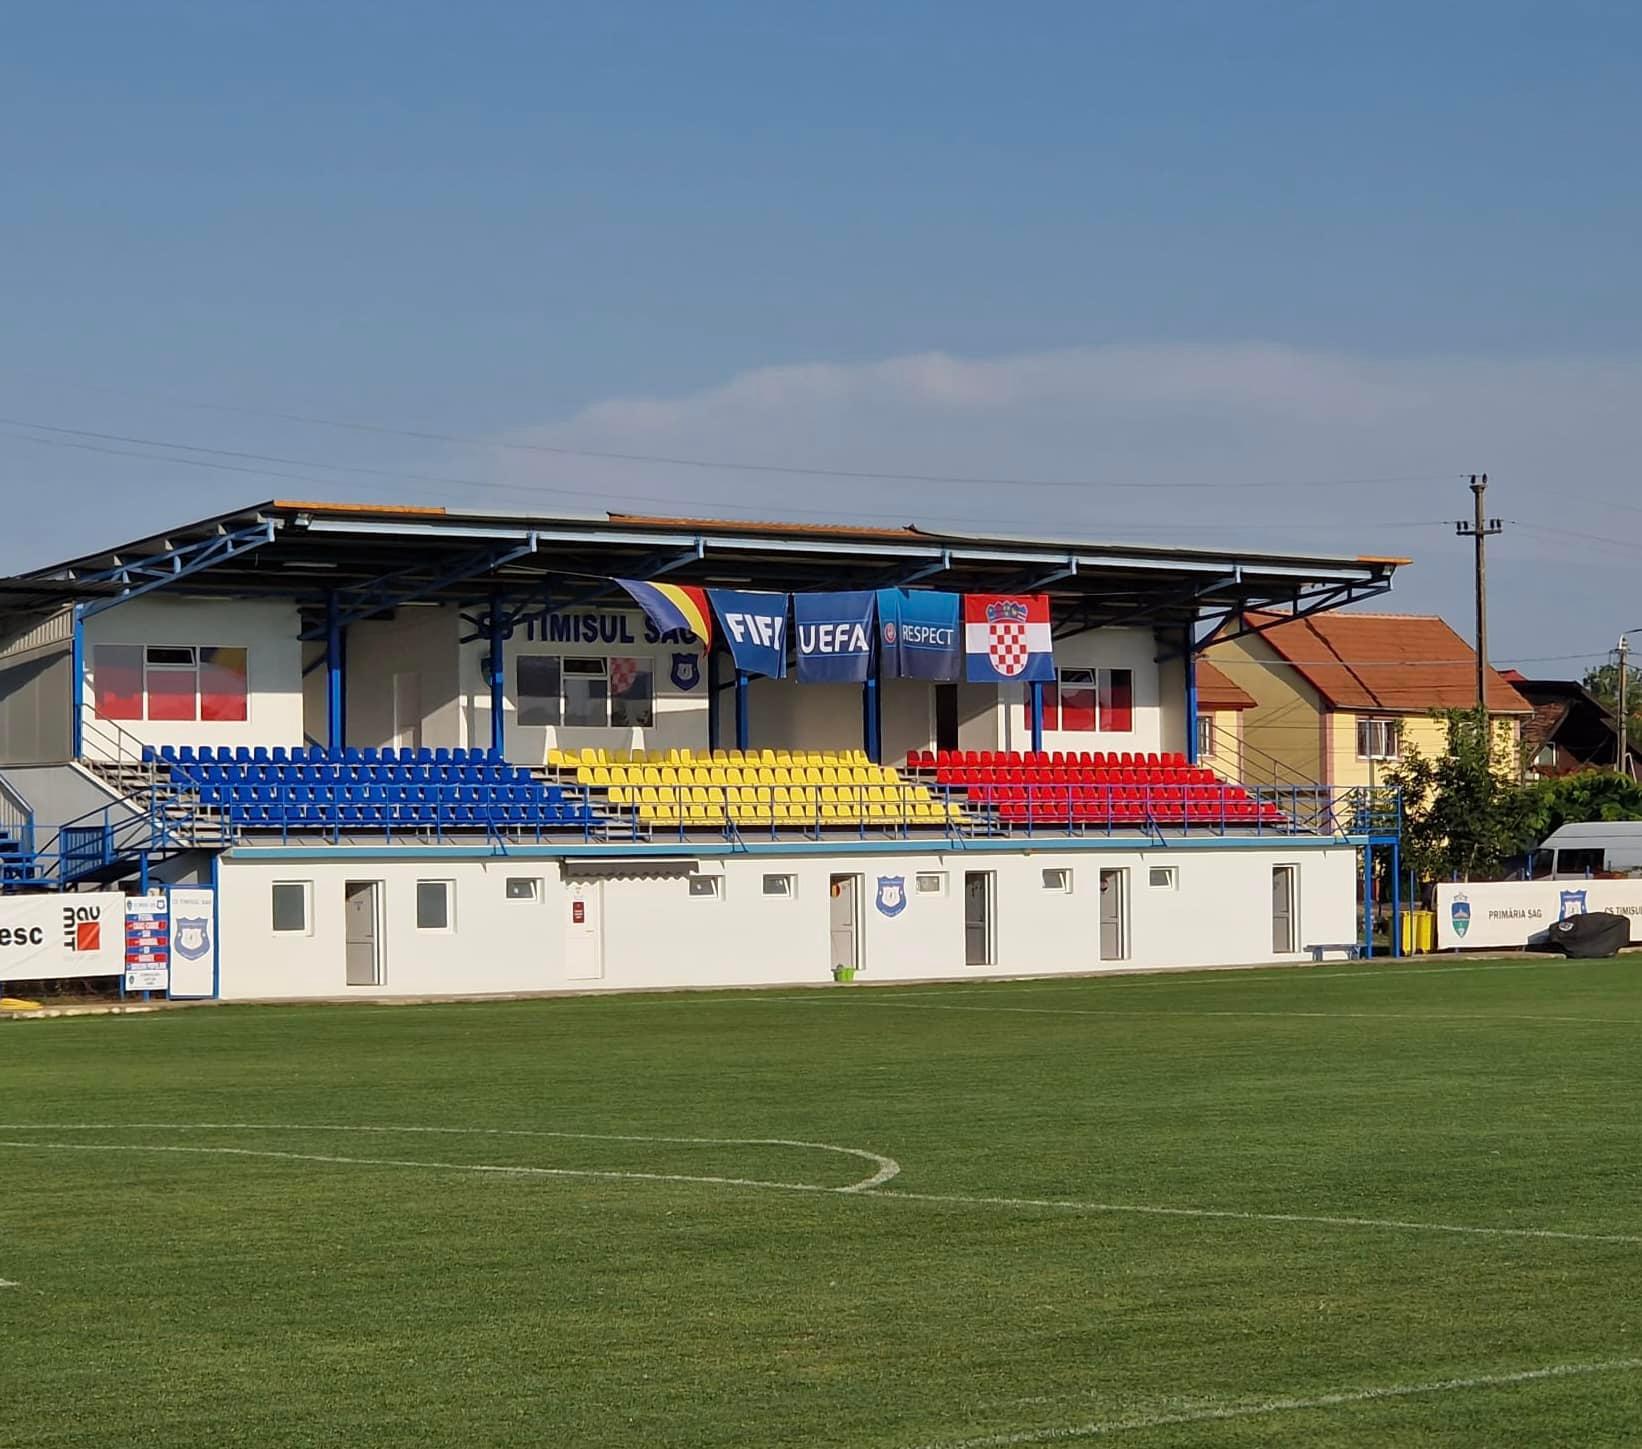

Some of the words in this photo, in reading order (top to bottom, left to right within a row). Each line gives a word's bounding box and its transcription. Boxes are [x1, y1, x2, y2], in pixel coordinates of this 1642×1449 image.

[799, 623, 870, 653] UEFA
[902, 624, 954, 645] RESPECT
[0, 927, 43, 946] esc
